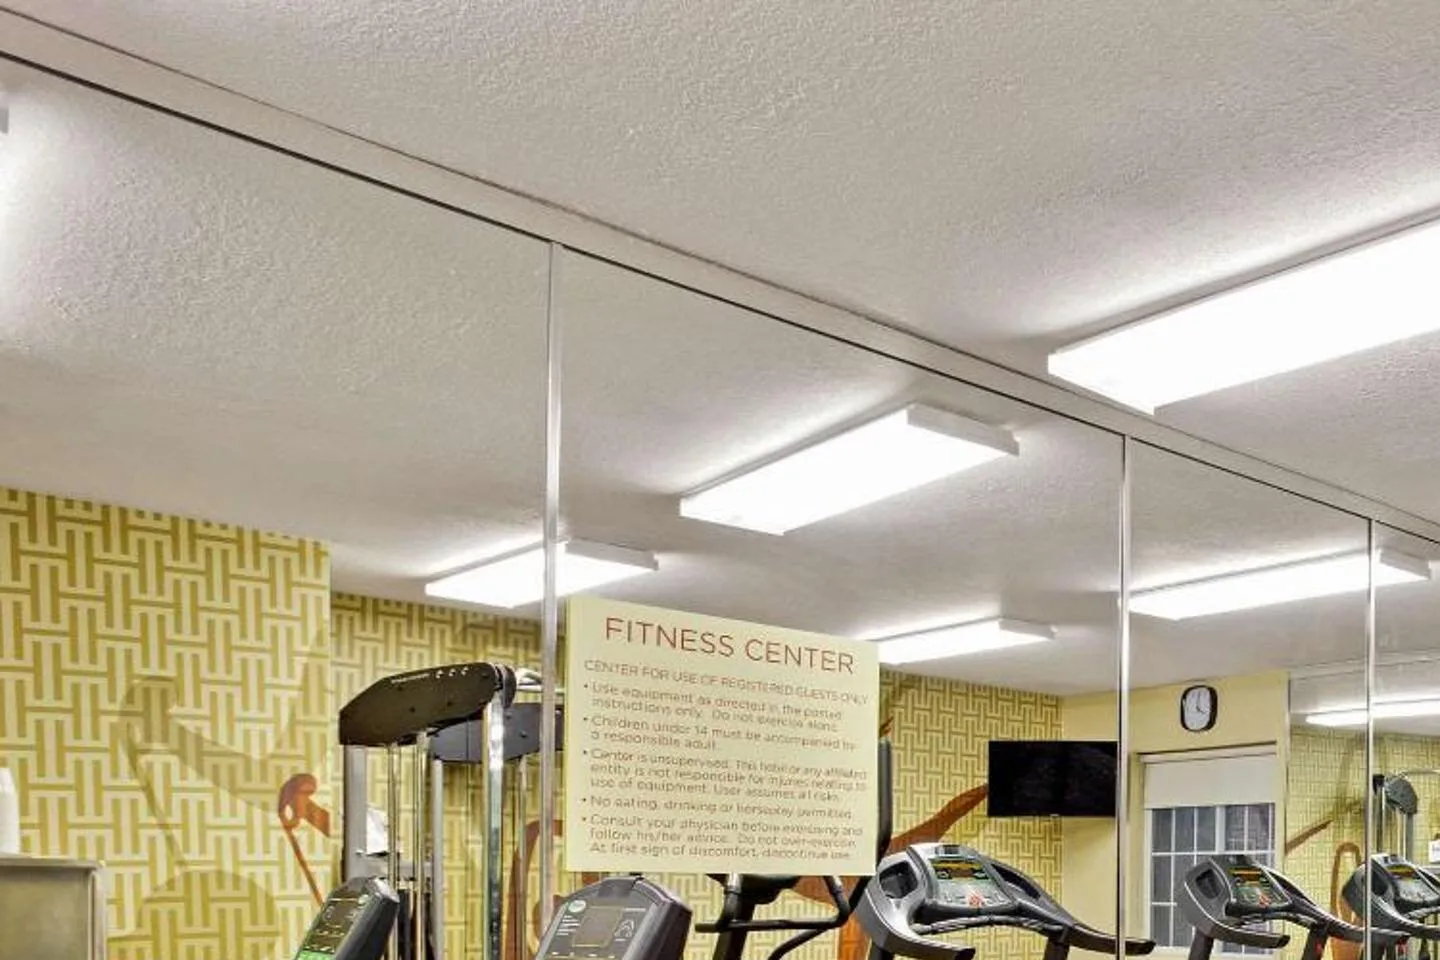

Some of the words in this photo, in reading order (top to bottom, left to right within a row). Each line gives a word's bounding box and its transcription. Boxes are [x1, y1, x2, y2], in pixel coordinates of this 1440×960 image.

[606, 616, 734, 658] FITNESS
[745, 638, 853, 674] CENTER
[584, 660, 638, 676] CENTER
[642, 666, 669, 681] FOR
[672, 670, 698, 684] USE
[782, 704, 801, 715] the
[591, 795, 611, 808] No
